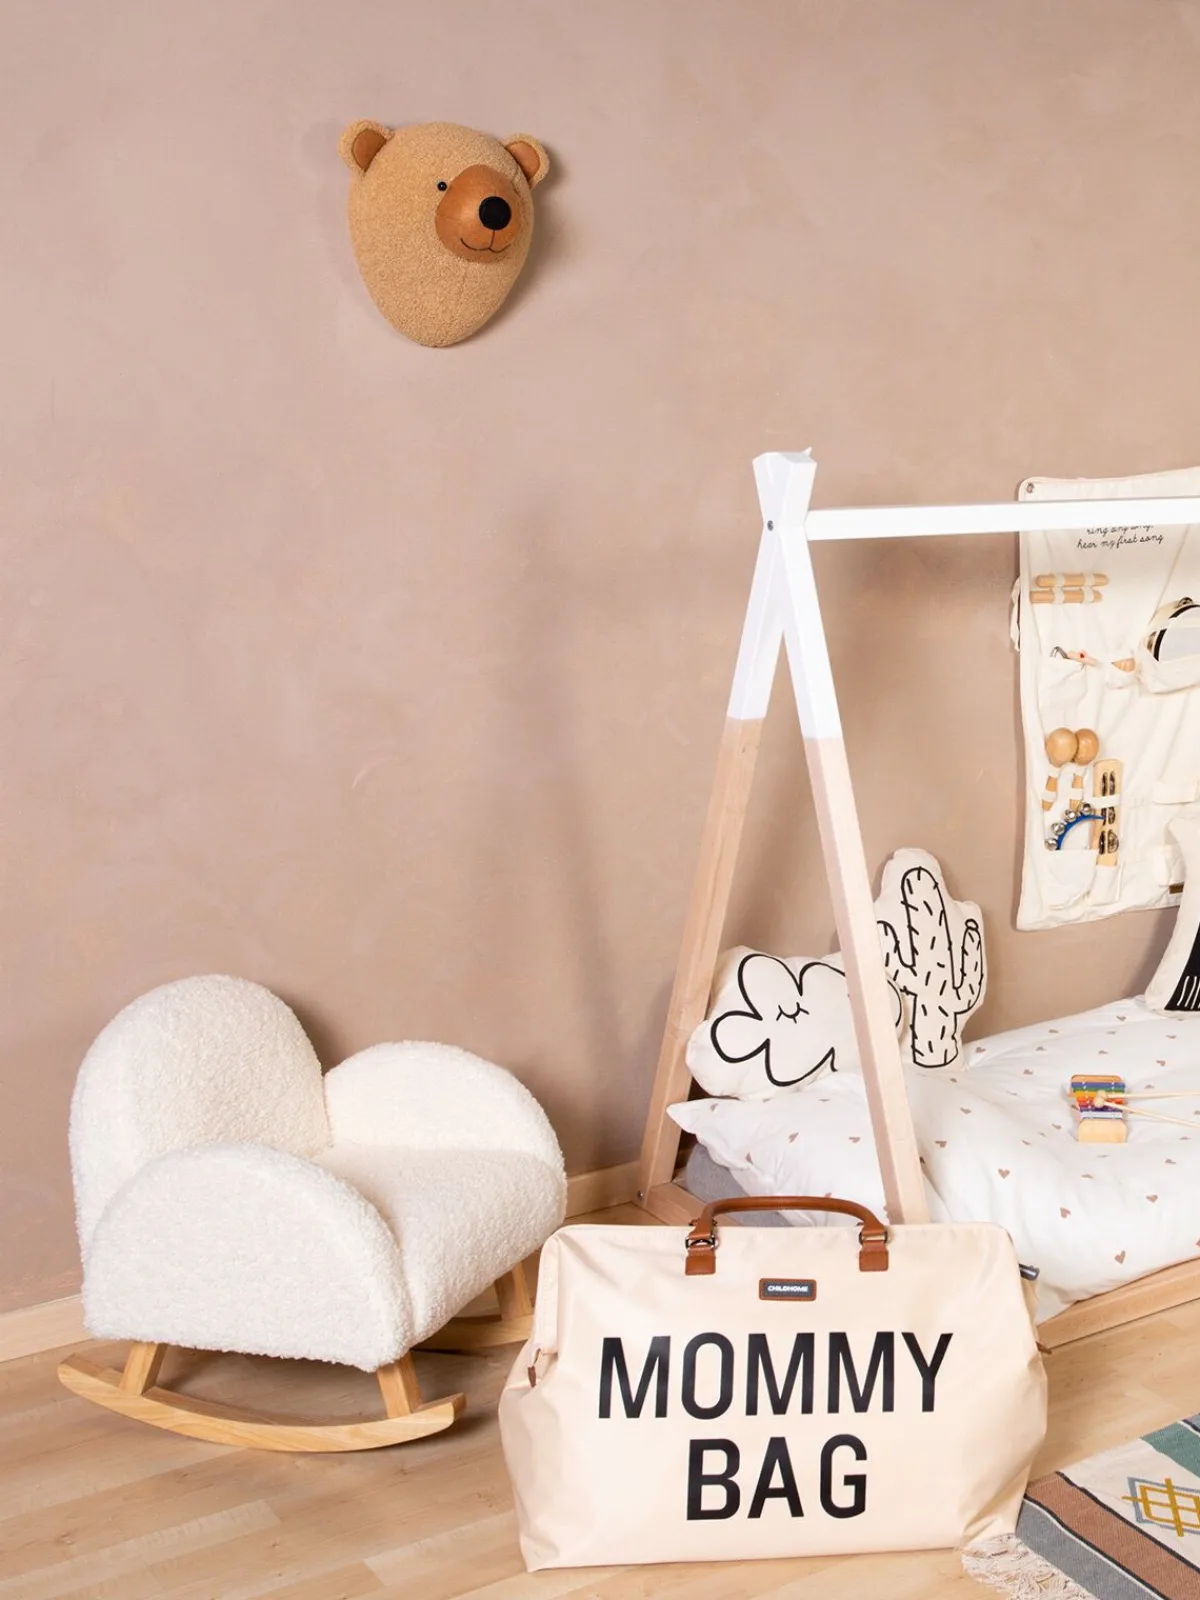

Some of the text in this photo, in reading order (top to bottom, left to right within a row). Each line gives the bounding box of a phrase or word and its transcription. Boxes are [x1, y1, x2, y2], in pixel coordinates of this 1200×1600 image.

[1077, 535, 1163, 549] hear my first song
[599, 1331, 954, 1420] MOMMY
[686, 1433, 869, 1521] BAG
